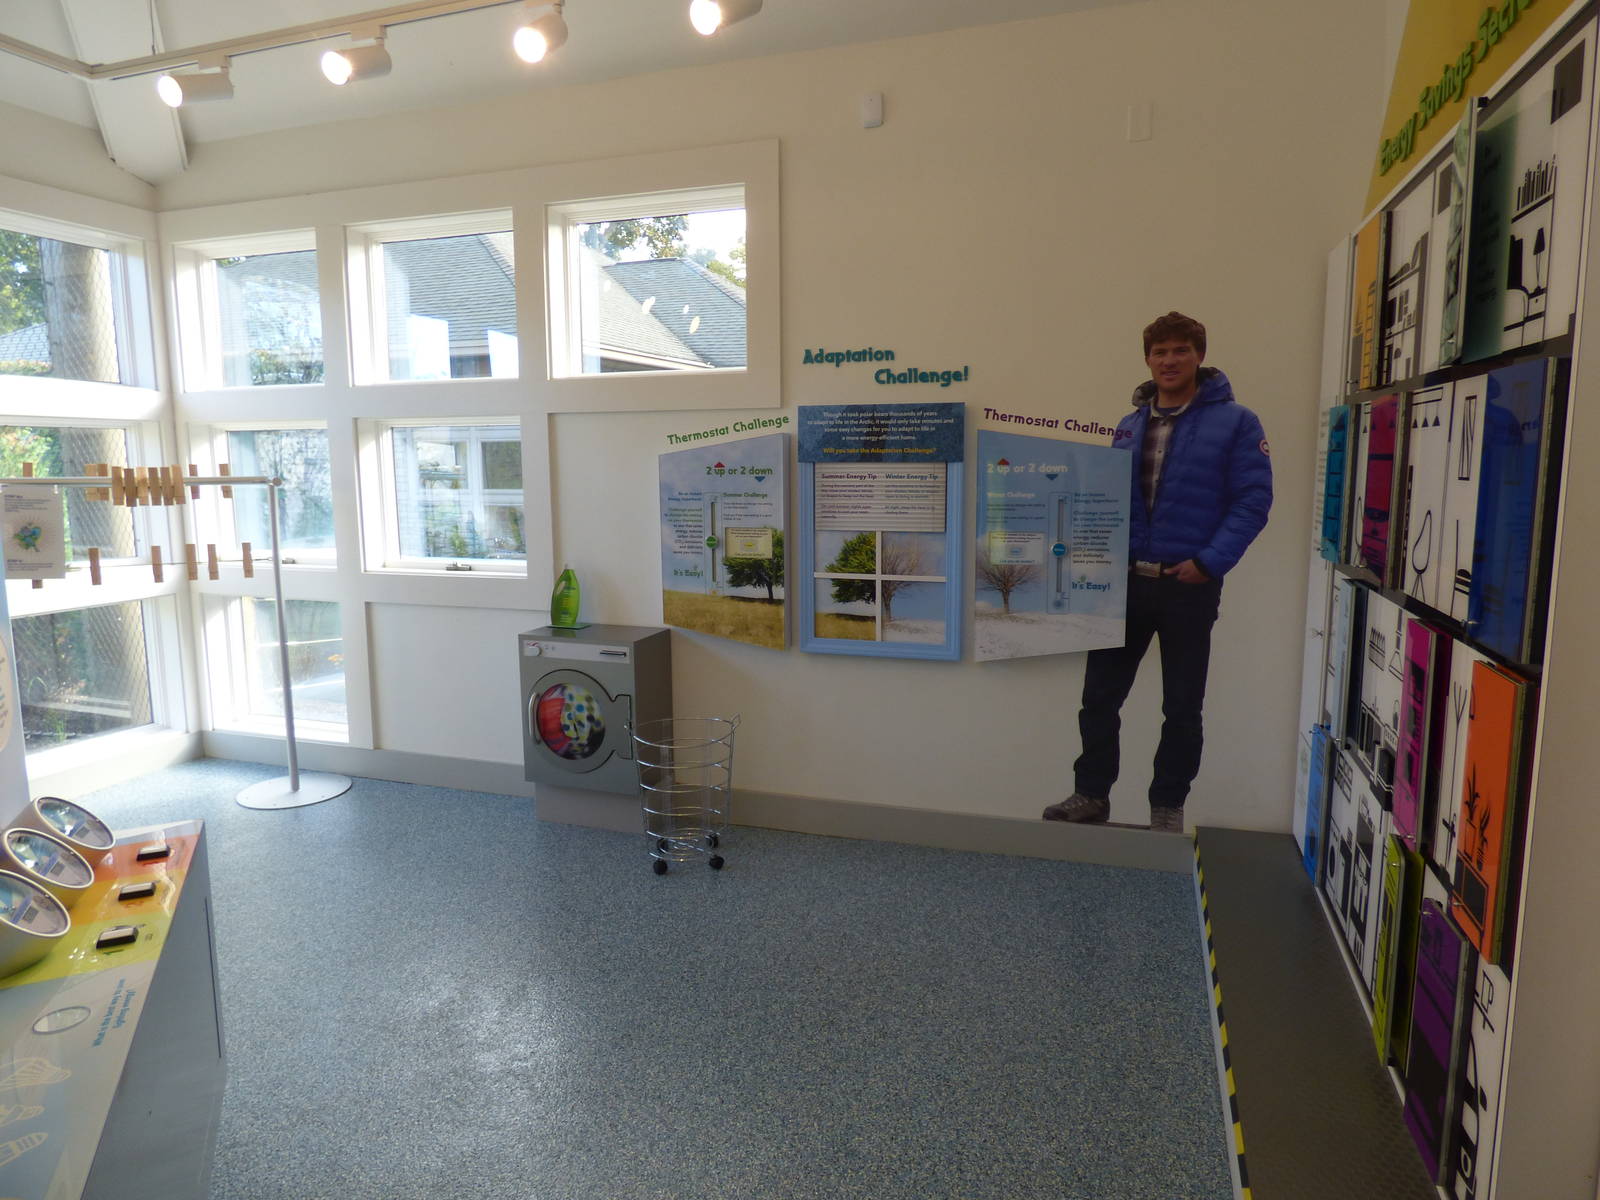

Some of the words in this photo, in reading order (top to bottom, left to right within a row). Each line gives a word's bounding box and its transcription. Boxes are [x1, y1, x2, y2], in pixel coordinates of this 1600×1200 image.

[1380, 112, 1418, 176] Energy
[1418, 41, 1476, 131] Savings
[803, 347, 895, 368] Adaptation
[874, 366, 968, 387] Challenge!
[667, 426, 729, 444] Thermostat
[732, 416, 790, 432] Challenge
[984, 408, 1059, 428] Thermostat
[1064, 419, 1133, 440] Challenge
[706, 466, 712, 475] 2
[714, 468, 725, 478] up
[740, 466, 746, 475] 2
[749, 466, 773, 475] down
[987, 463, 994, 473] 2
[997, 466, 1010, 476] up
[1014, 465, 1025, 473] or
[1028, 463, 1037, 472] 2
[1038, 463, 1068, 473] down
[684, 569, 704, 578] Easy!
[1072, 582, 1084, 590] It's
[1086, 582, 1111, 592] Easy!
